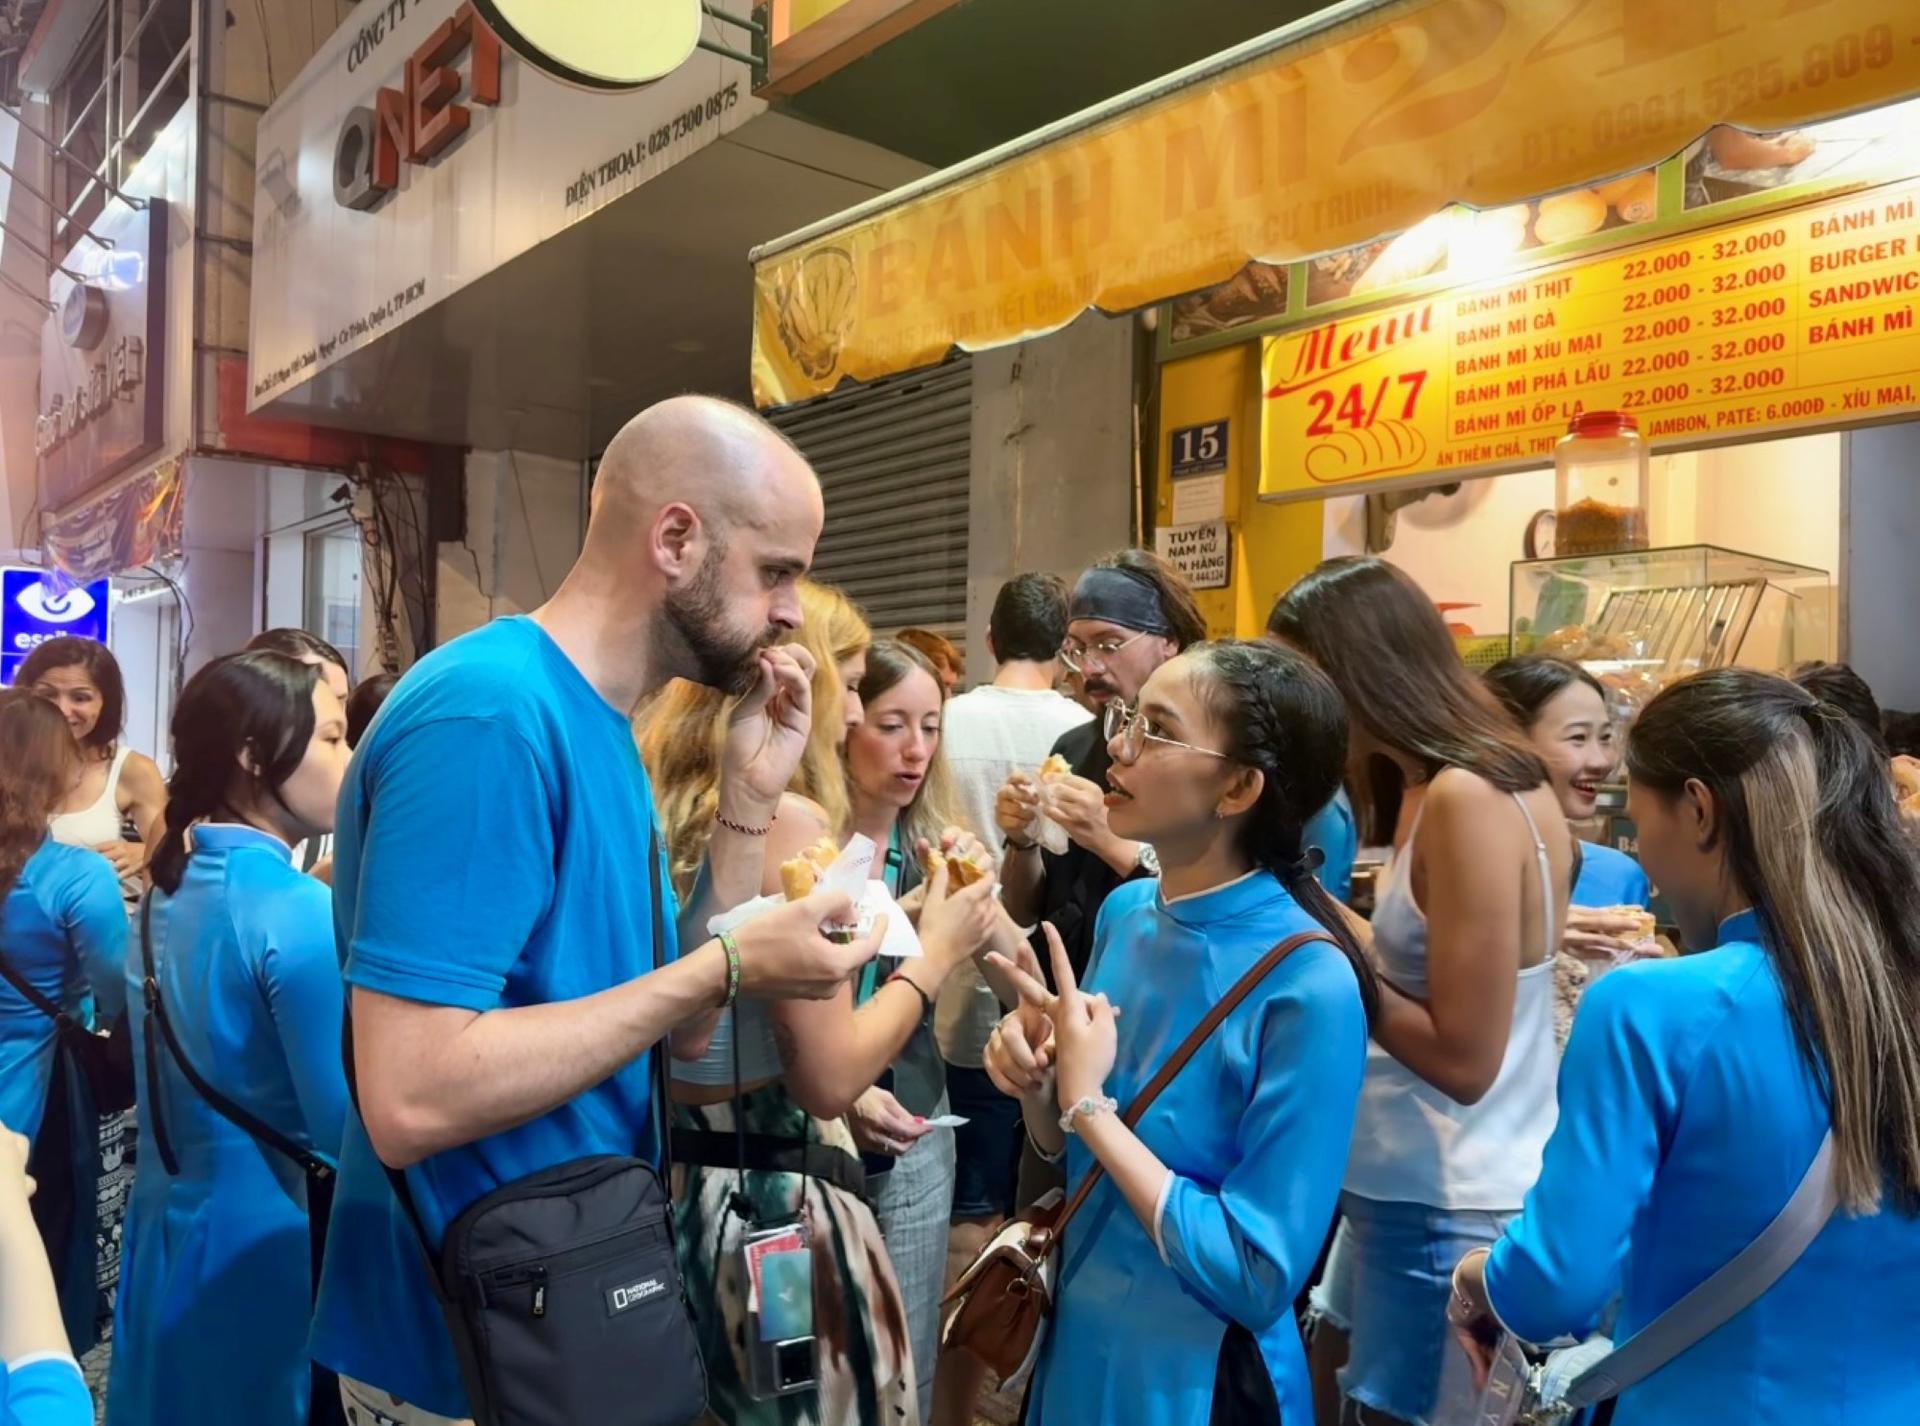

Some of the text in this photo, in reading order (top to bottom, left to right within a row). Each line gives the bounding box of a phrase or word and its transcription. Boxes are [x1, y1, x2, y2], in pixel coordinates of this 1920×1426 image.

[648, 124, 670, 156] 028
[673, 103, 704, 142] 7300
[705, 81, 738, 121] 0875
[868, 157, 1113, 318] BÁNH
[1809, 196, 1913, 240] BÁNH MÌ
[1534, 276, 1573, 300] THỊT
[1622, 250, 1691, 281] 22.000
[1711, 229, 1786, 261] 32.000
[1809, 238, 1907, 274] BURGER
[405, 278, 426, 305] HCM
[1533, 308, 1557, 331] GÀ
[1622, 283, 1691, 313] 22.000
[1711, 262, 1786, 294] 32.000
[1278, 304, 1433, 384] Menu
[1533, 339, 1562, 362] XÍU
[1568, 333, 1603, 355] MẠI
[1622, 316, 1691, 345] 22.000
[1711, 297, 1786, 328] 32.000
[1809, 305, 1913, 345] BÁNH MÌ
[1506, 374, 1527, 397] MÌ
[1532, 368, 1568, 393] PHÁ
[1574, 358, 1611, 386] LẤU
[1621, 349, 1690, 378] 22.000
[1710, 332, 1785, 362] 32.000
[1306, 369, 1428, 438] 24/7
[1455, 412, 1500, 436] BÁNH
[1506, 404, 1526, 428] MÌ
[1532, 398, 1557, 423] ỐP
[1621, 382, 1690, 409] 22.000
[1710, 366, 1784, 396] 32.000
[1647, 412, 1711, 437] JAMBON,
[1717, 406, 1761, 429] PATE:
[1766, 397, 1825, 421] 6.000Đ
[1841, 387, 1872, 409] XÍU
[1877, 384, 1917, 406] MẠI,
[1180, 424, 1219, 464] 15
[1168, 544, 1196, 558] NAM
[1191, 555, 1224, 571] HÀNG
